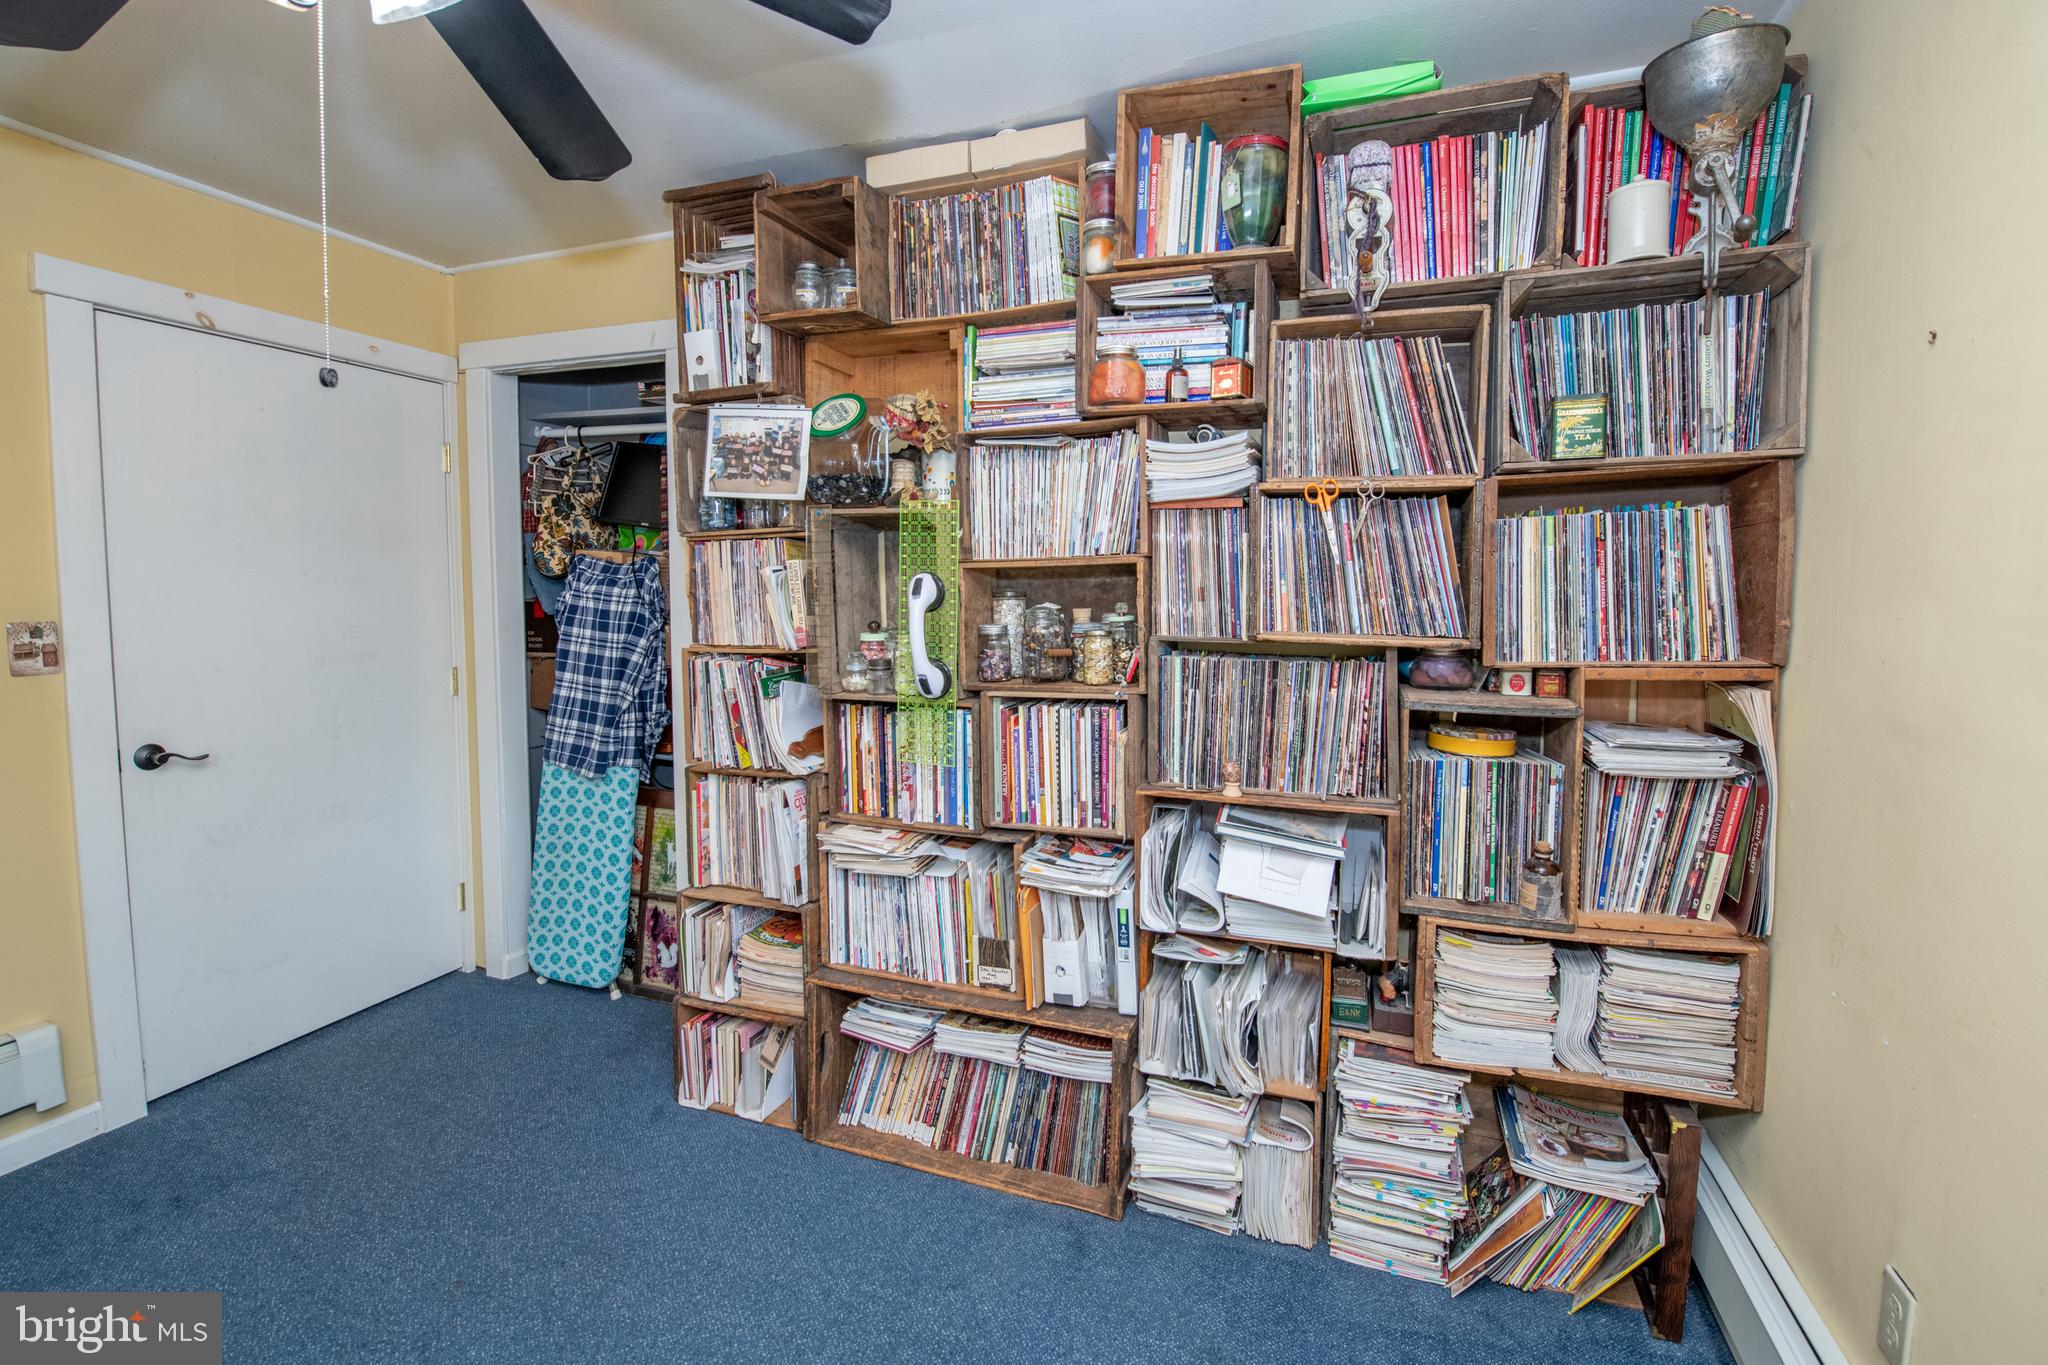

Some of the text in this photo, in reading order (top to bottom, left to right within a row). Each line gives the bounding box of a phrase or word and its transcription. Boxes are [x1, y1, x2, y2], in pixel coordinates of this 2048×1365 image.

[1767, 102, 1776, 134] CHRISTMAS
[1777, 100, 1787, 133] CHRISTMAS
[1703, 340, 1712, 368] Country
[1733, 788, 1742, 810] PAINTER'S
[1709, 810, 1724, 847] TREASURES
[1729, 810, 1737, 825] QUICK
[1722, 825, 1734, 851] REFERENCE
[1749, 842, 1759, 874] LOWELL
[1338, 1007, 1361, 1017] BANK
